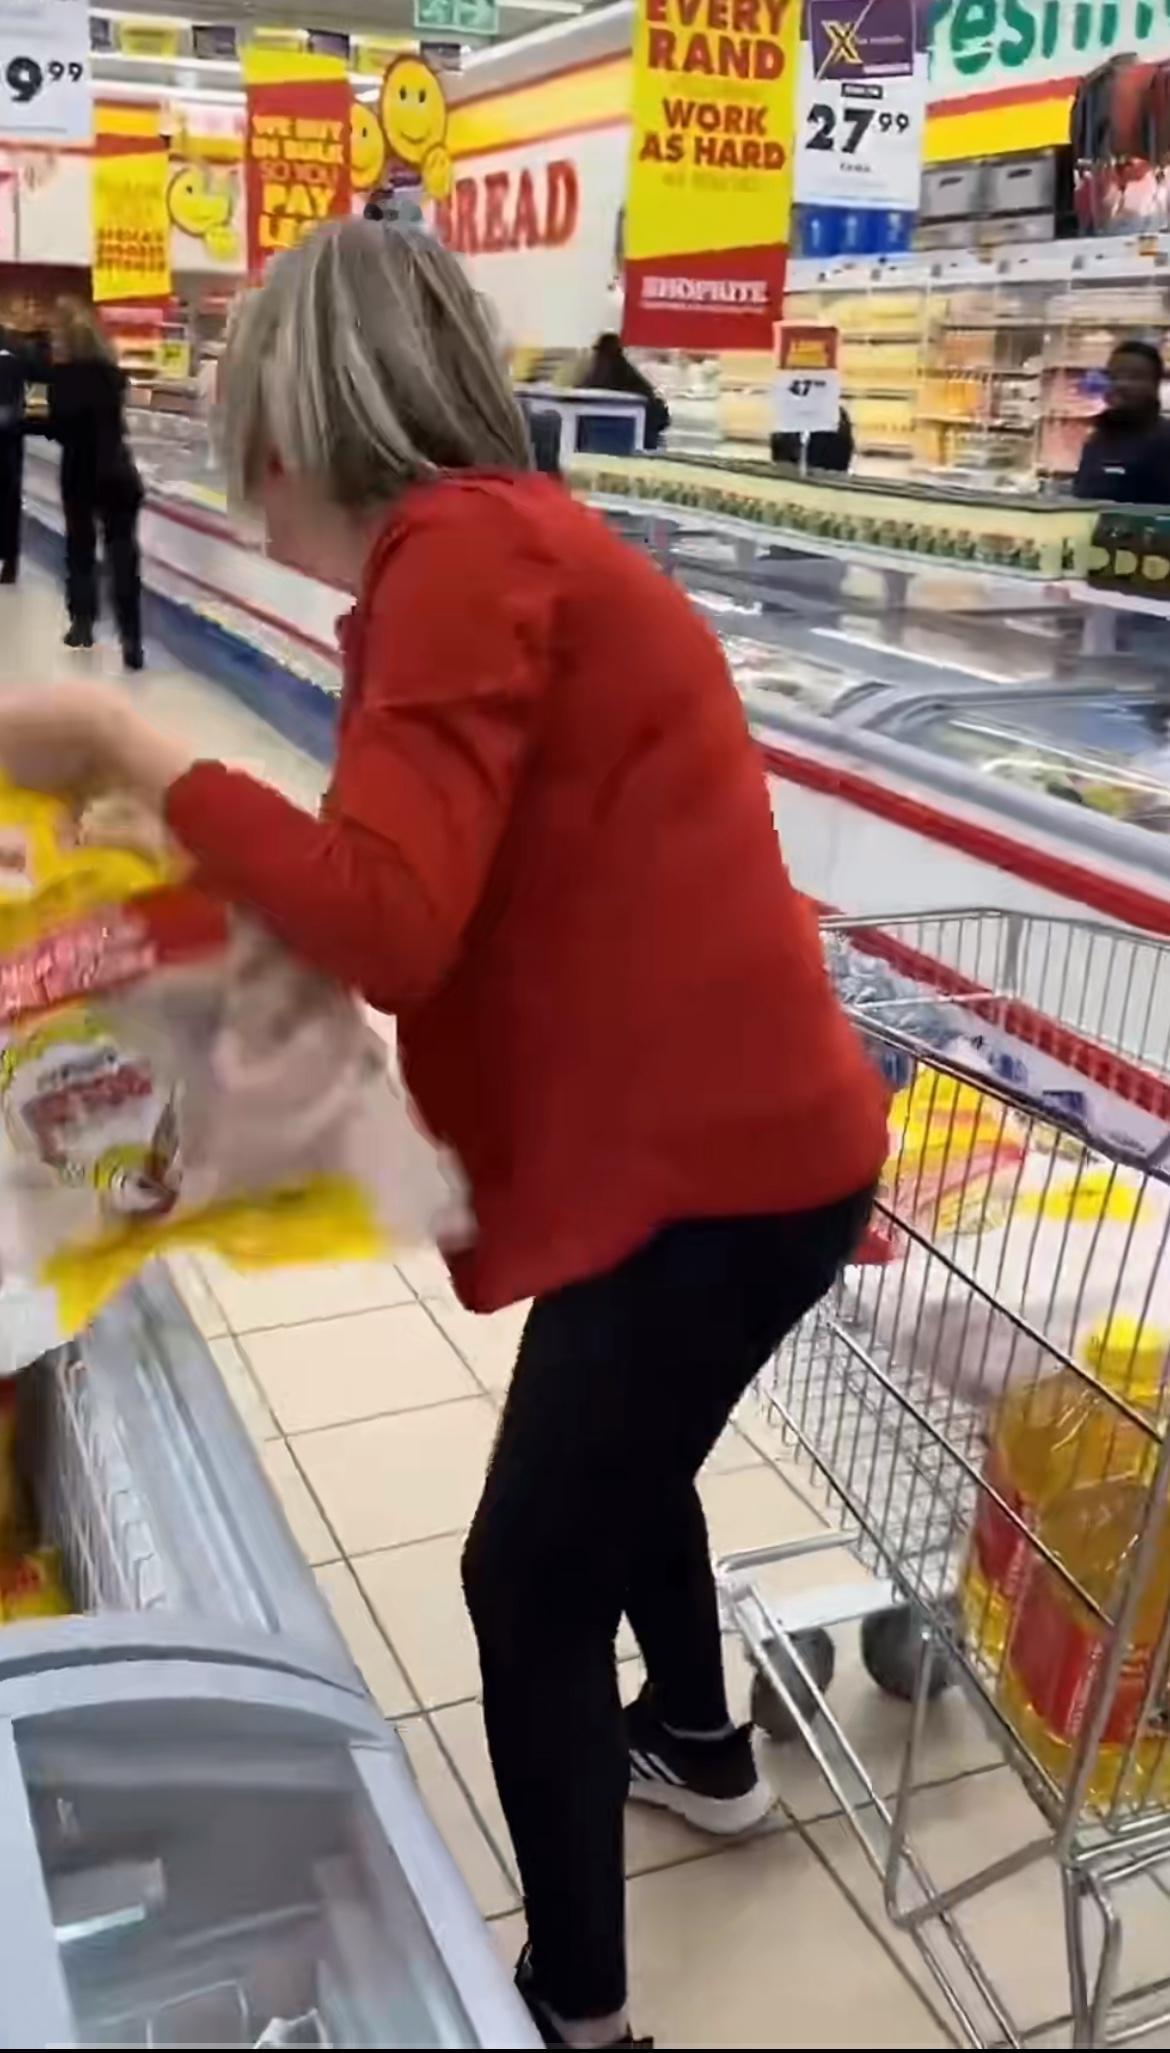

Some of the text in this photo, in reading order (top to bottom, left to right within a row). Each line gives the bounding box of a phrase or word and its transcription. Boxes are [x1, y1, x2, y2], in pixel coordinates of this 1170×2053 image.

[645, 0, 790, 35] EVERY
[648, 28, 785, 80] RAND
[662, 98, 768, 136] WORK
[639, 131, 786, 170] AS HARD
[259, 159, 339, 187] SO YOU
[263, 183, 335, 218] PAY
